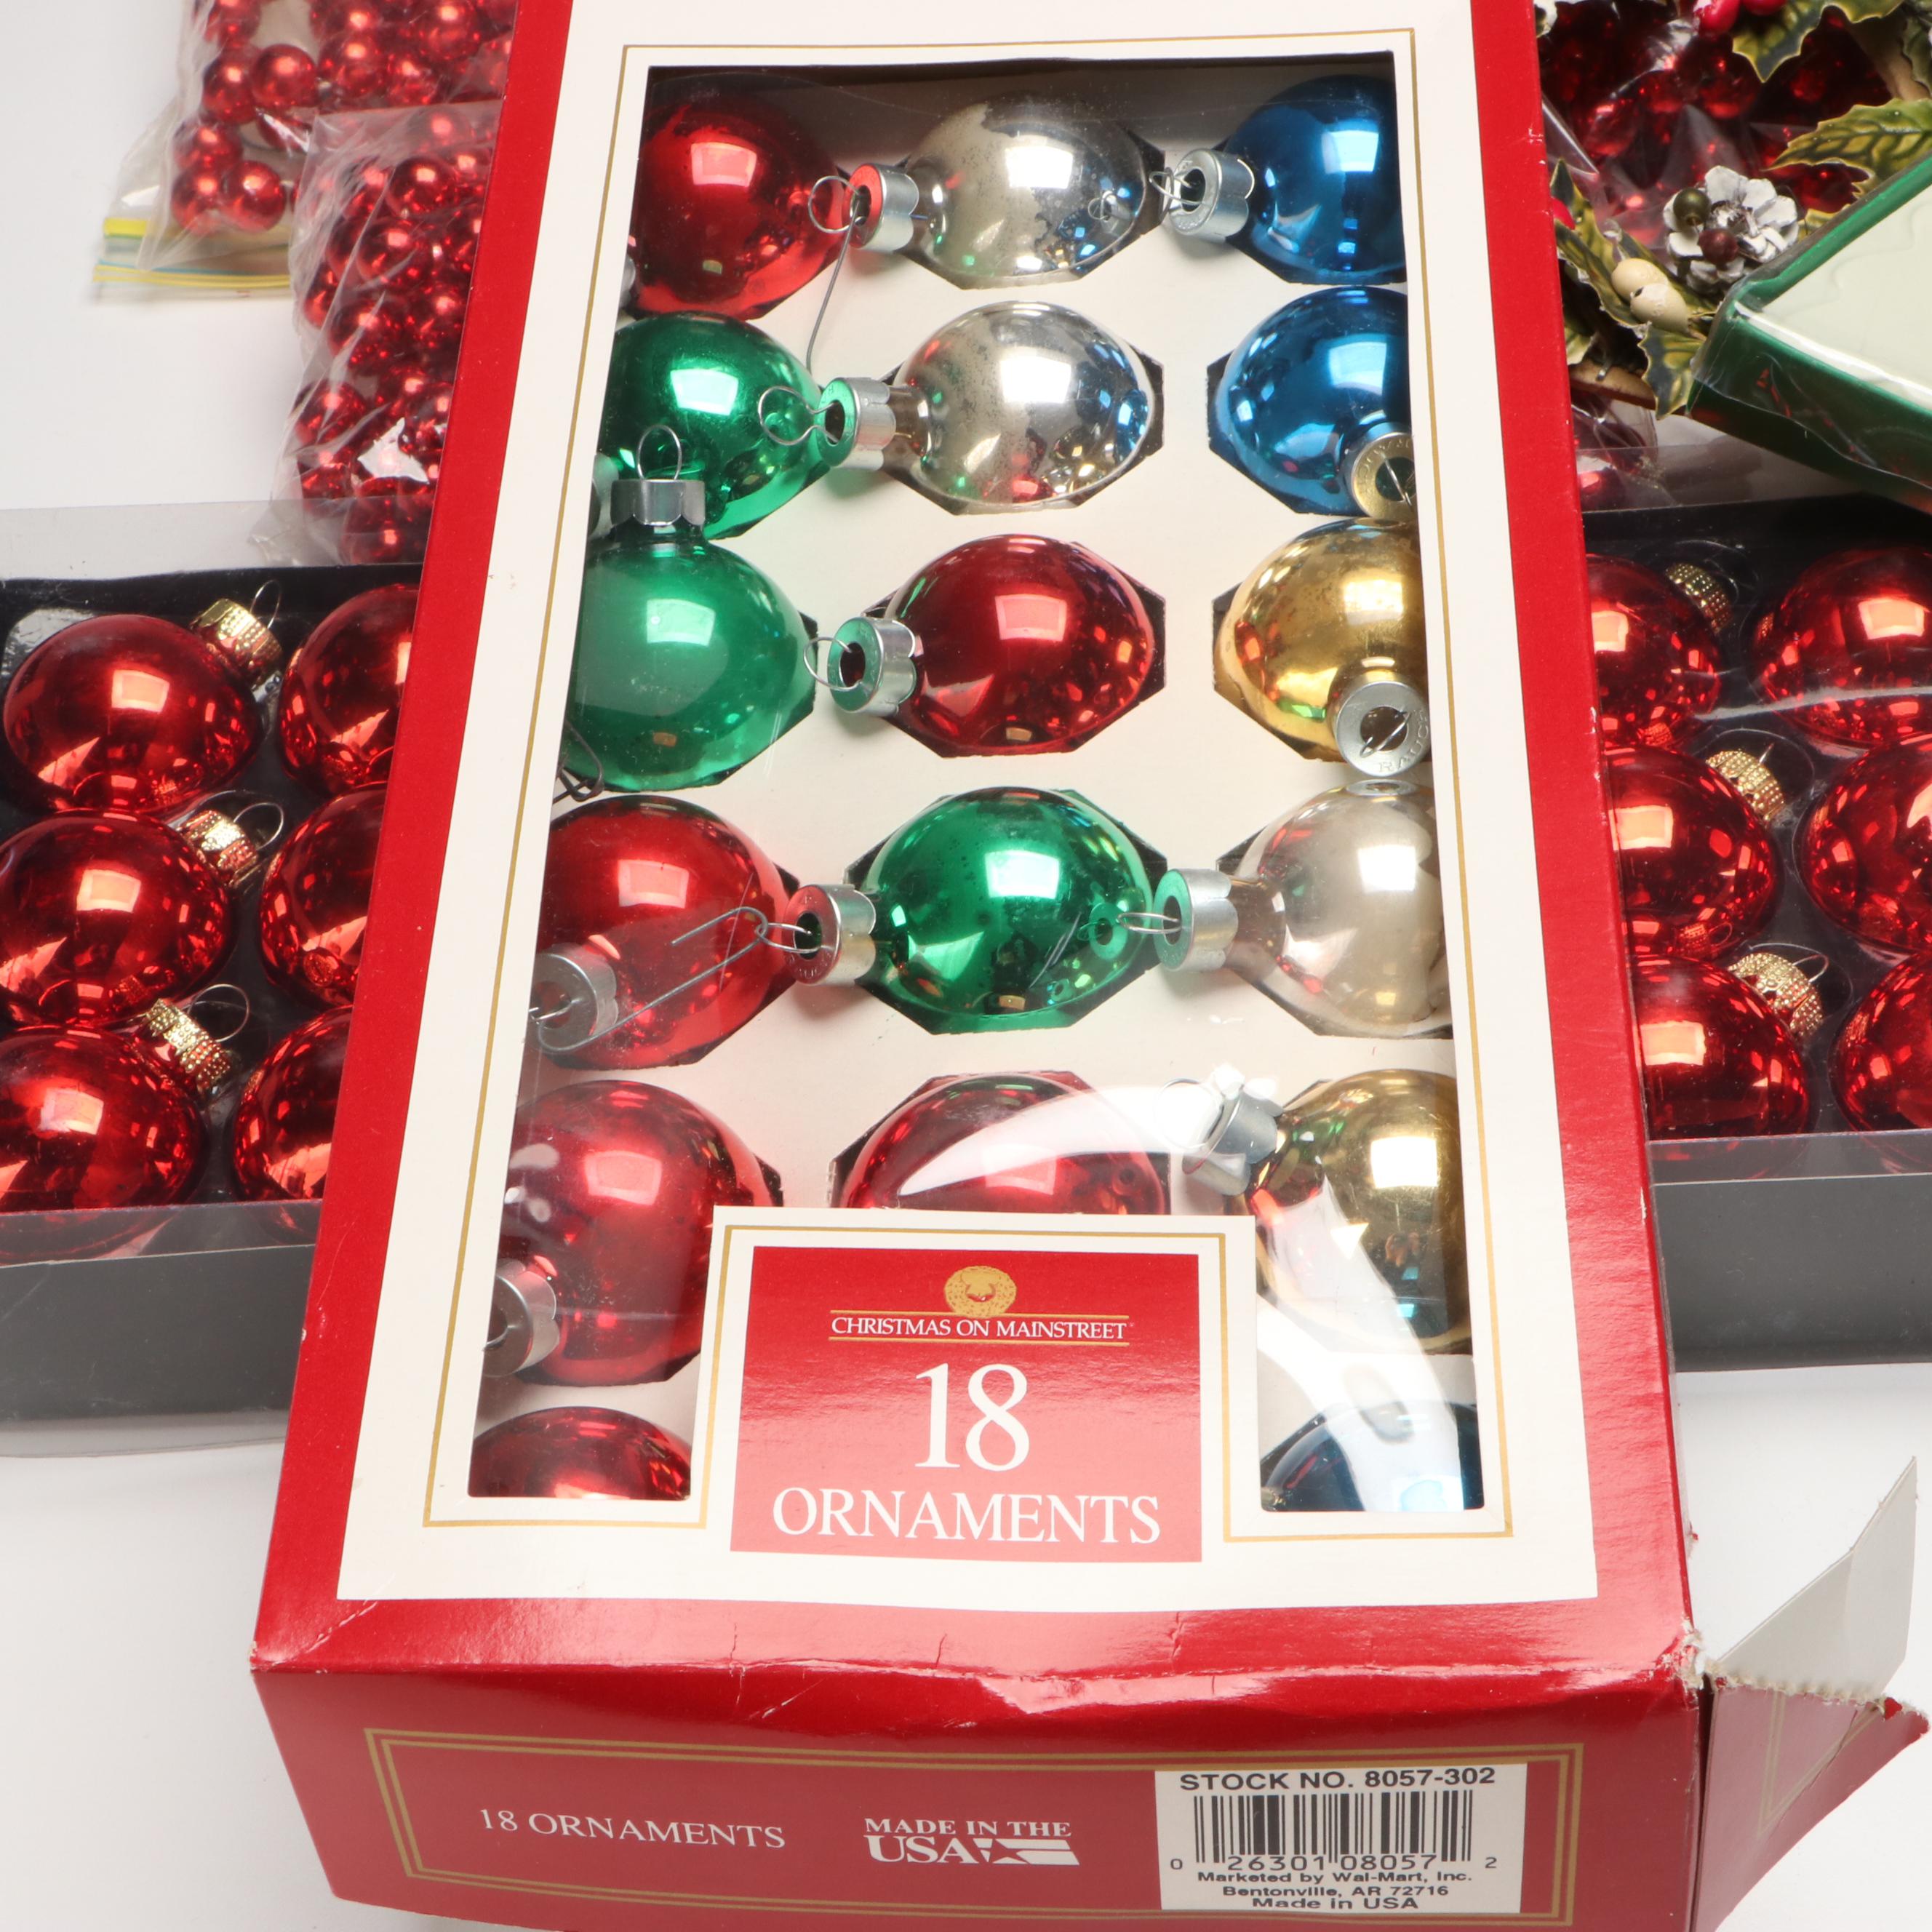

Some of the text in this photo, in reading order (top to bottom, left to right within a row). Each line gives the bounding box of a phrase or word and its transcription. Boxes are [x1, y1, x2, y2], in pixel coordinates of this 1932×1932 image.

[831, 1317, 1127, 1340] CHRISTMAS ON MAINSTREET
[914, 1362, 1030, 1472] 18
[773, 1487, 1161, 1544] ORNAMENTS
[1180, 1766, 1496, 1791] STOCK NO. 8057-302
[480, 1808, 786, 1848] 18 ORNAMENTS
[864, 1818, 1071, 1837] MADE IN THE
[863, 1835, 980, 1864] USA
[1170, 1859, 1183, 1870] 0
[1485, 1856, 1498, 1869] 2
[1197, 1871, 1472, 1885] Marketed by Wal-Mart, Inc.
[1222, 1885, 1449, 1899] Bentonville, AR 72716
[1252, 1896, 1419, 1909] Made in USA
